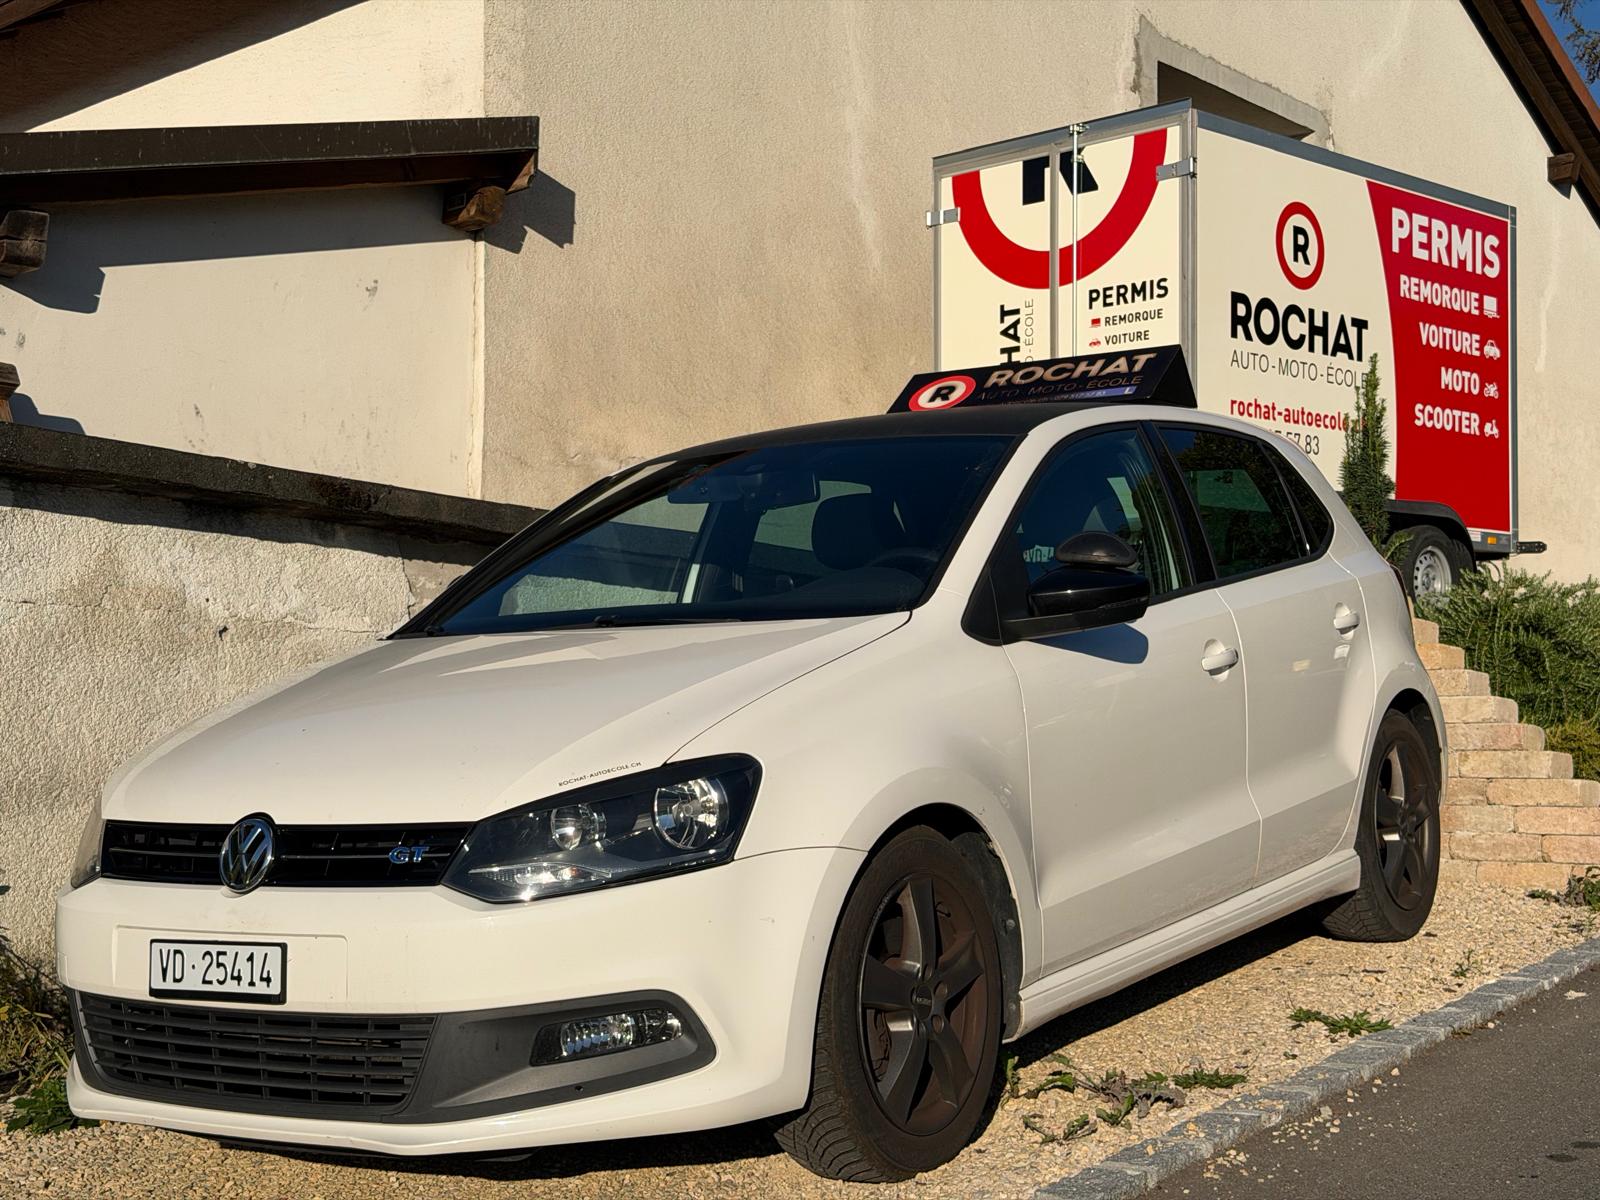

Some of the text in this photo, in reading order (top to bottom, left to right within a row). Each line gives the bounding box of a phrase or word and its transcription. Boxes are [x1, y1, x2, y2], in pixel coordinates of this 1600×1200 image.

[1293, 225, 1311, 265] R
[1391, 207, 1500, 278] PERMIS
[1088, 277, 1169, 310] PERMIS
[1400, 274, 1480, 316] REMORQUE
[1104, 308, 1164, 328] REMORQUE
[1231, 291, 1369, 363] ROCHAT
[1104, 330, 1150, 346] VOITURE
[1419, 322, 1480, 357] VOITURE
[983, 353, 1158, 389] ROCHAT
[1441, 366, 1480, 395] MOTO
[928, 385, 956, 403] R
[1414, 403, 1480, 436] SCOOTER
[1305, 434, 1320, 455] 83
[389, 846, 430, 864] GT
